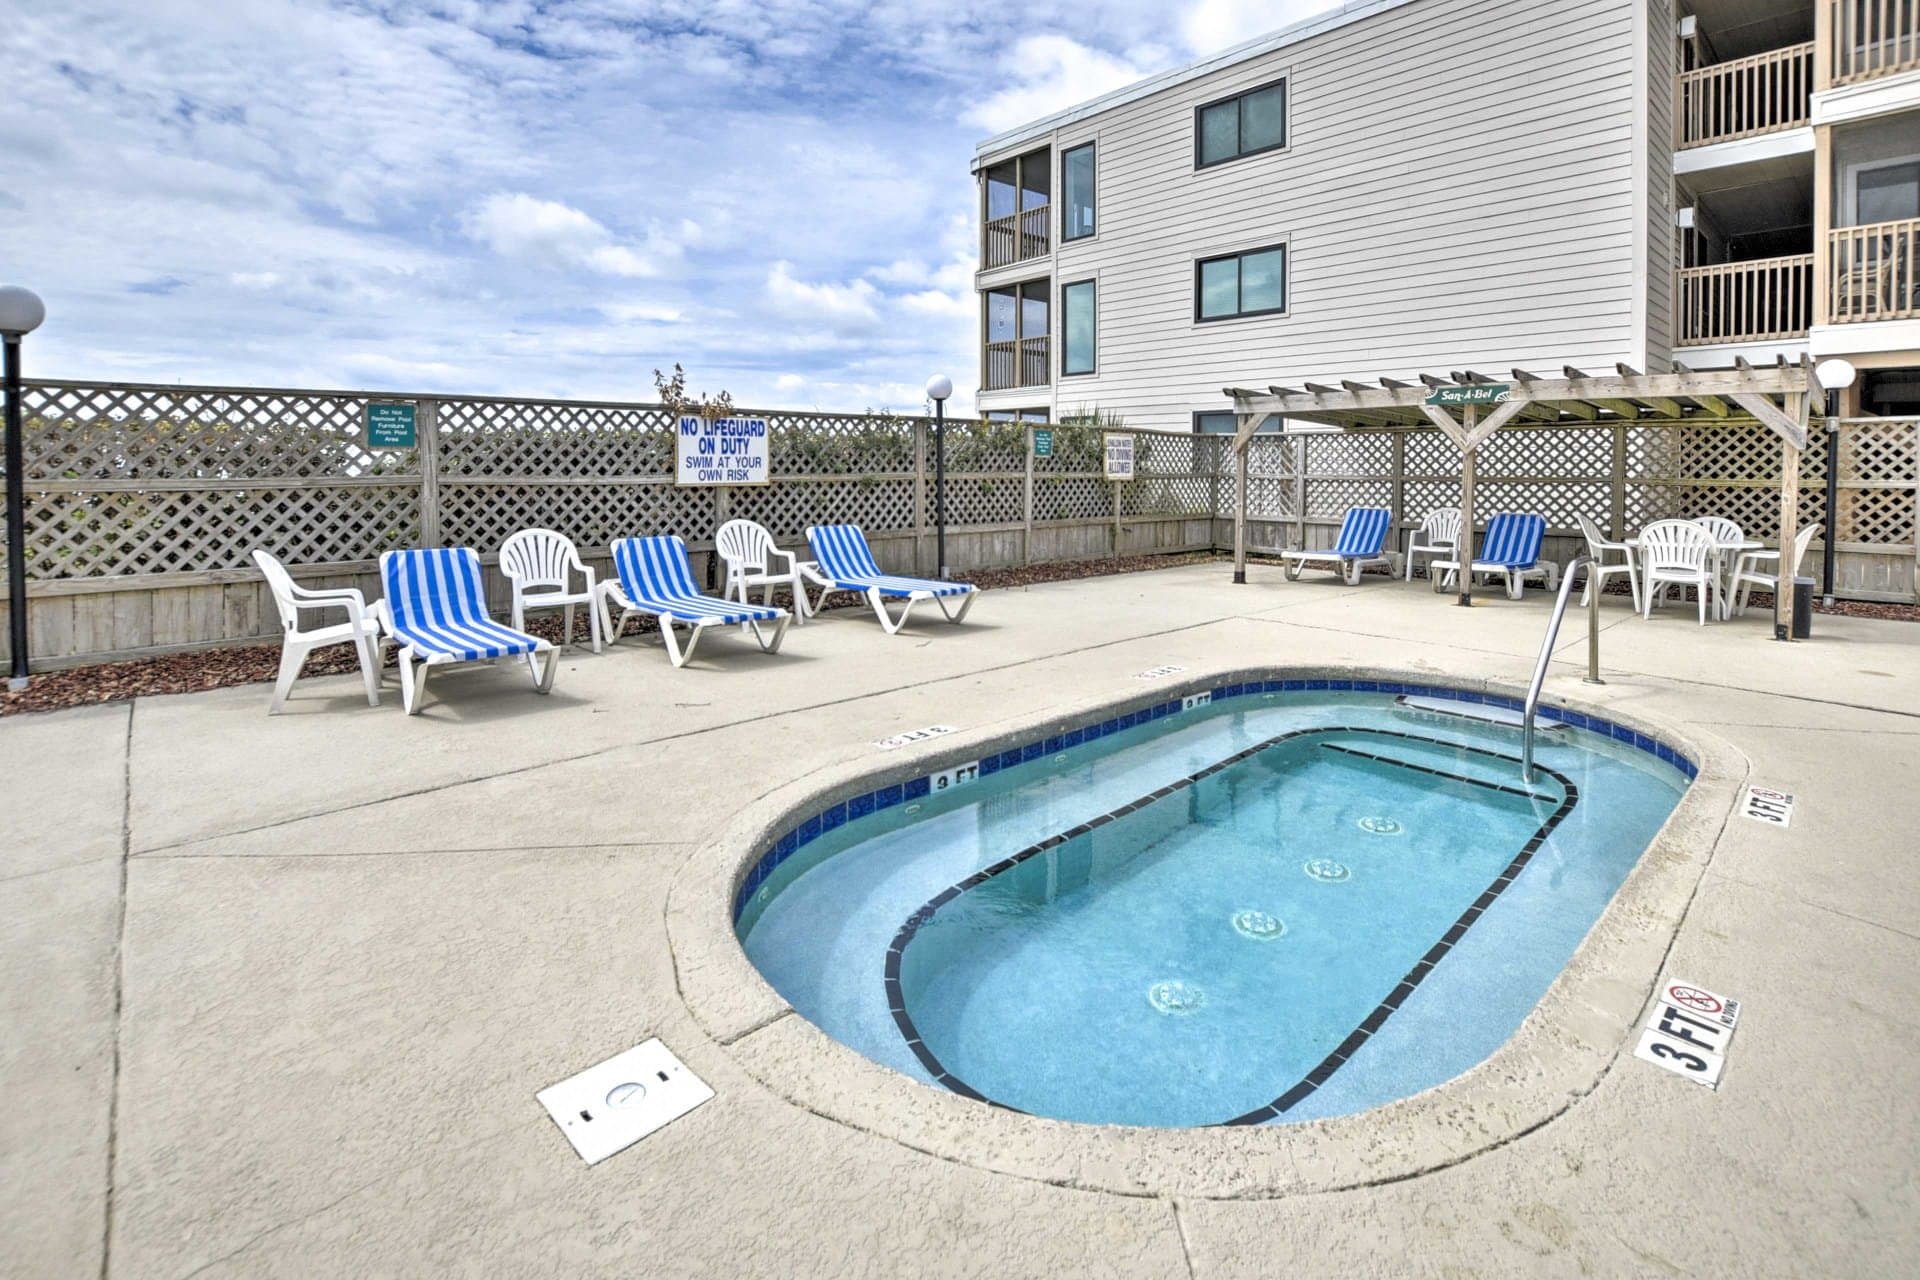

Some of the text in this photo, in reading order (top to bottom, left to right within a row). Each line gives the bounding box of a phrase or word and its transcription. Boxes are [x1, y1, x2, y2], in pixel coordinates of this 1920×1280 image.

[680, 418, 765, 437] NO LIFEGUARD
[698, 437, 750, 454] ON DUTY
[685, 456, 762, 468] SWIM AT YOUR
[698, 469, 749, 481] OWN RISK
[1747, 796, 1787, 822] 3 FT
[1720, 999, 1738, 1025] NO DIVING
[1650, 1006, 1720, 1072] 3 FT
